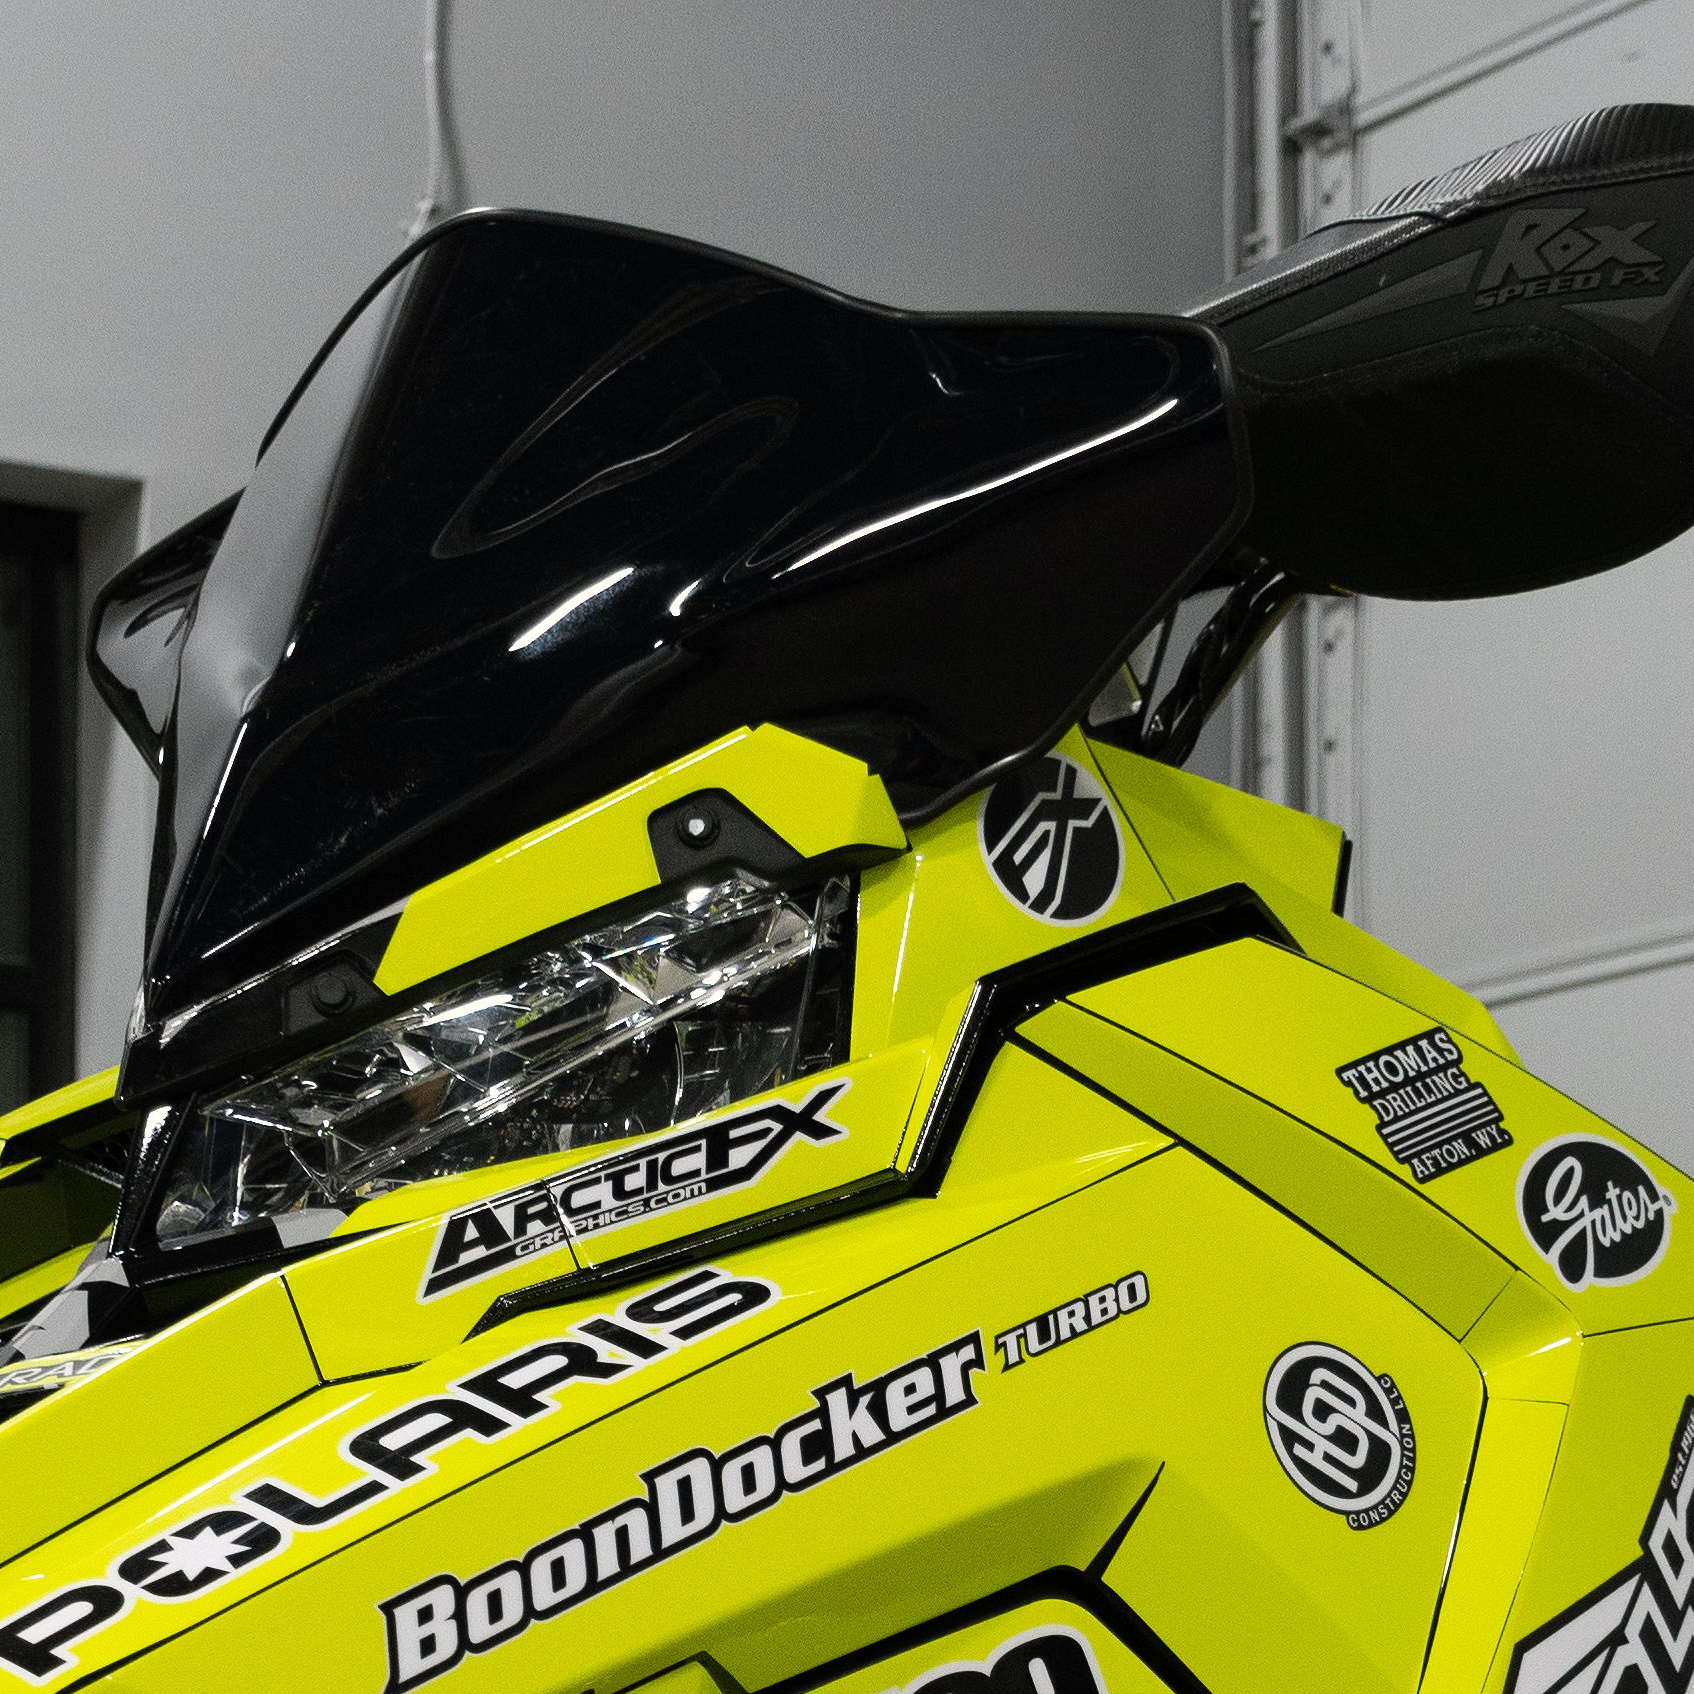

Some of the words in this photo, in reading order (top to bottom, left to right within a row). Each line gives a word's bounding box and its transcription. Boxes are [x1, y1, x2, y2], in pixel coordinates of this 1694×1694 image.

[1474, 271, 1602, 312] SPEED
[1609, 262, 1665, 287] FX
[1341, 1031, 1459, 1099] THOMAS
[1373, 1067, 1469, 1122] DRILLING
[1472, 1122, 1510, 1152] WY.
[1540, 1155, 1667, 1284] Gates
[999, 1272, 1148, 1368] TURBO
[1380, 1376, 1405, 1410] LLC
[1348, 1423, 1415, 1528] CONSTRUCTION
